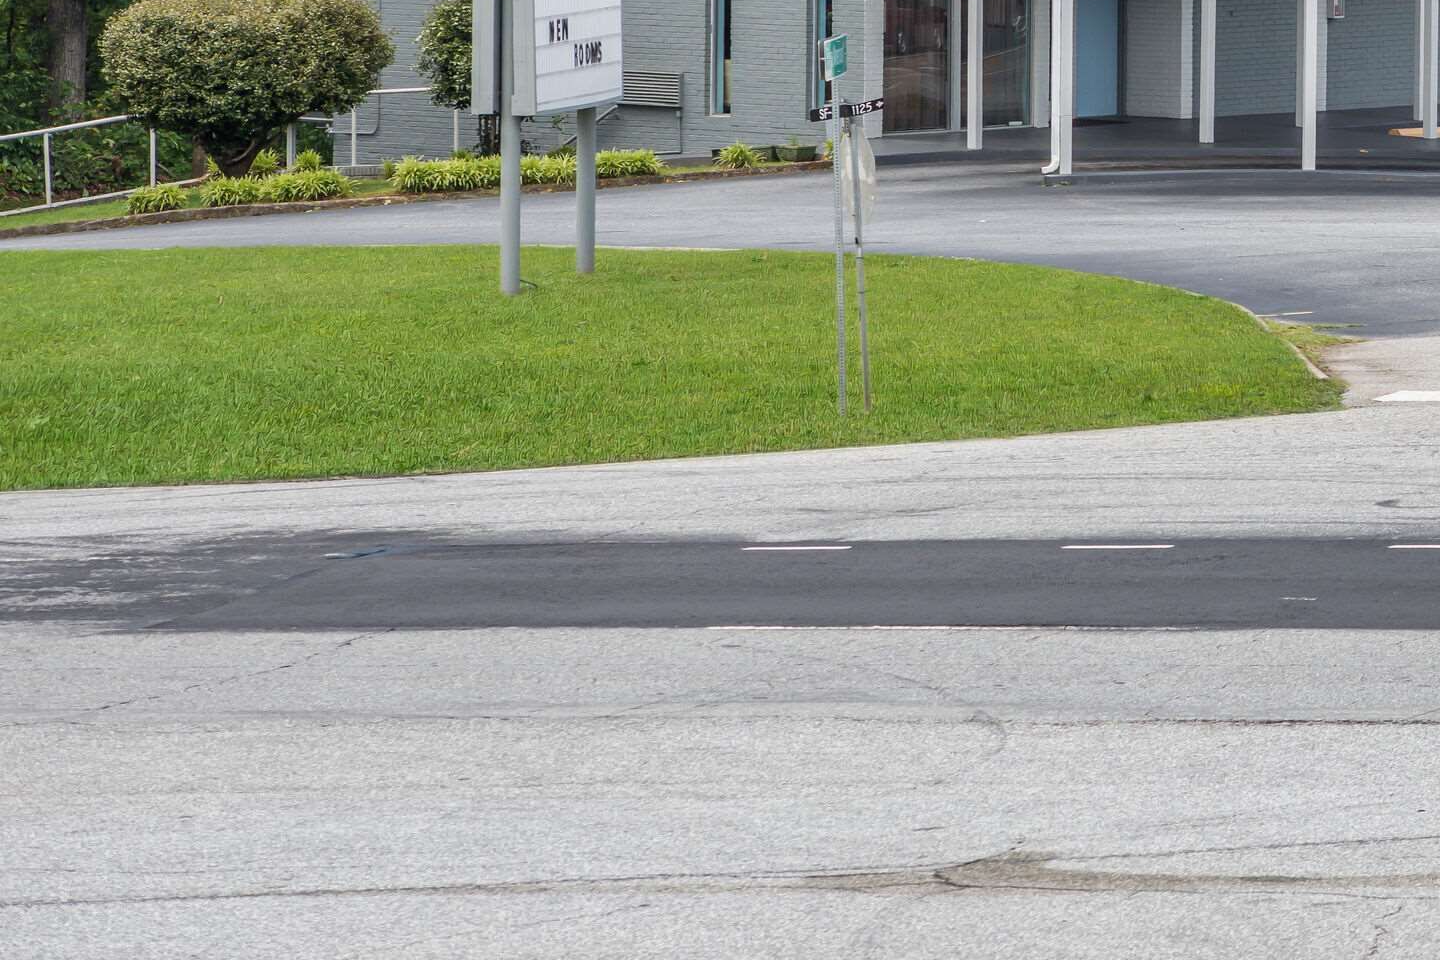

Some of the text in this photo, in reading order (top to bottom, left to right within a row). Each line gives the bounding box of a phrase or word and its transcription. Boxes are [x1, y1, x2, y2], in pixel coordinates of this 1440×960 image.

[549, 17, 569, 44] NEW
[574, 40, 602, 68] ROOMS
[851, 102, 873, 115] 1125
